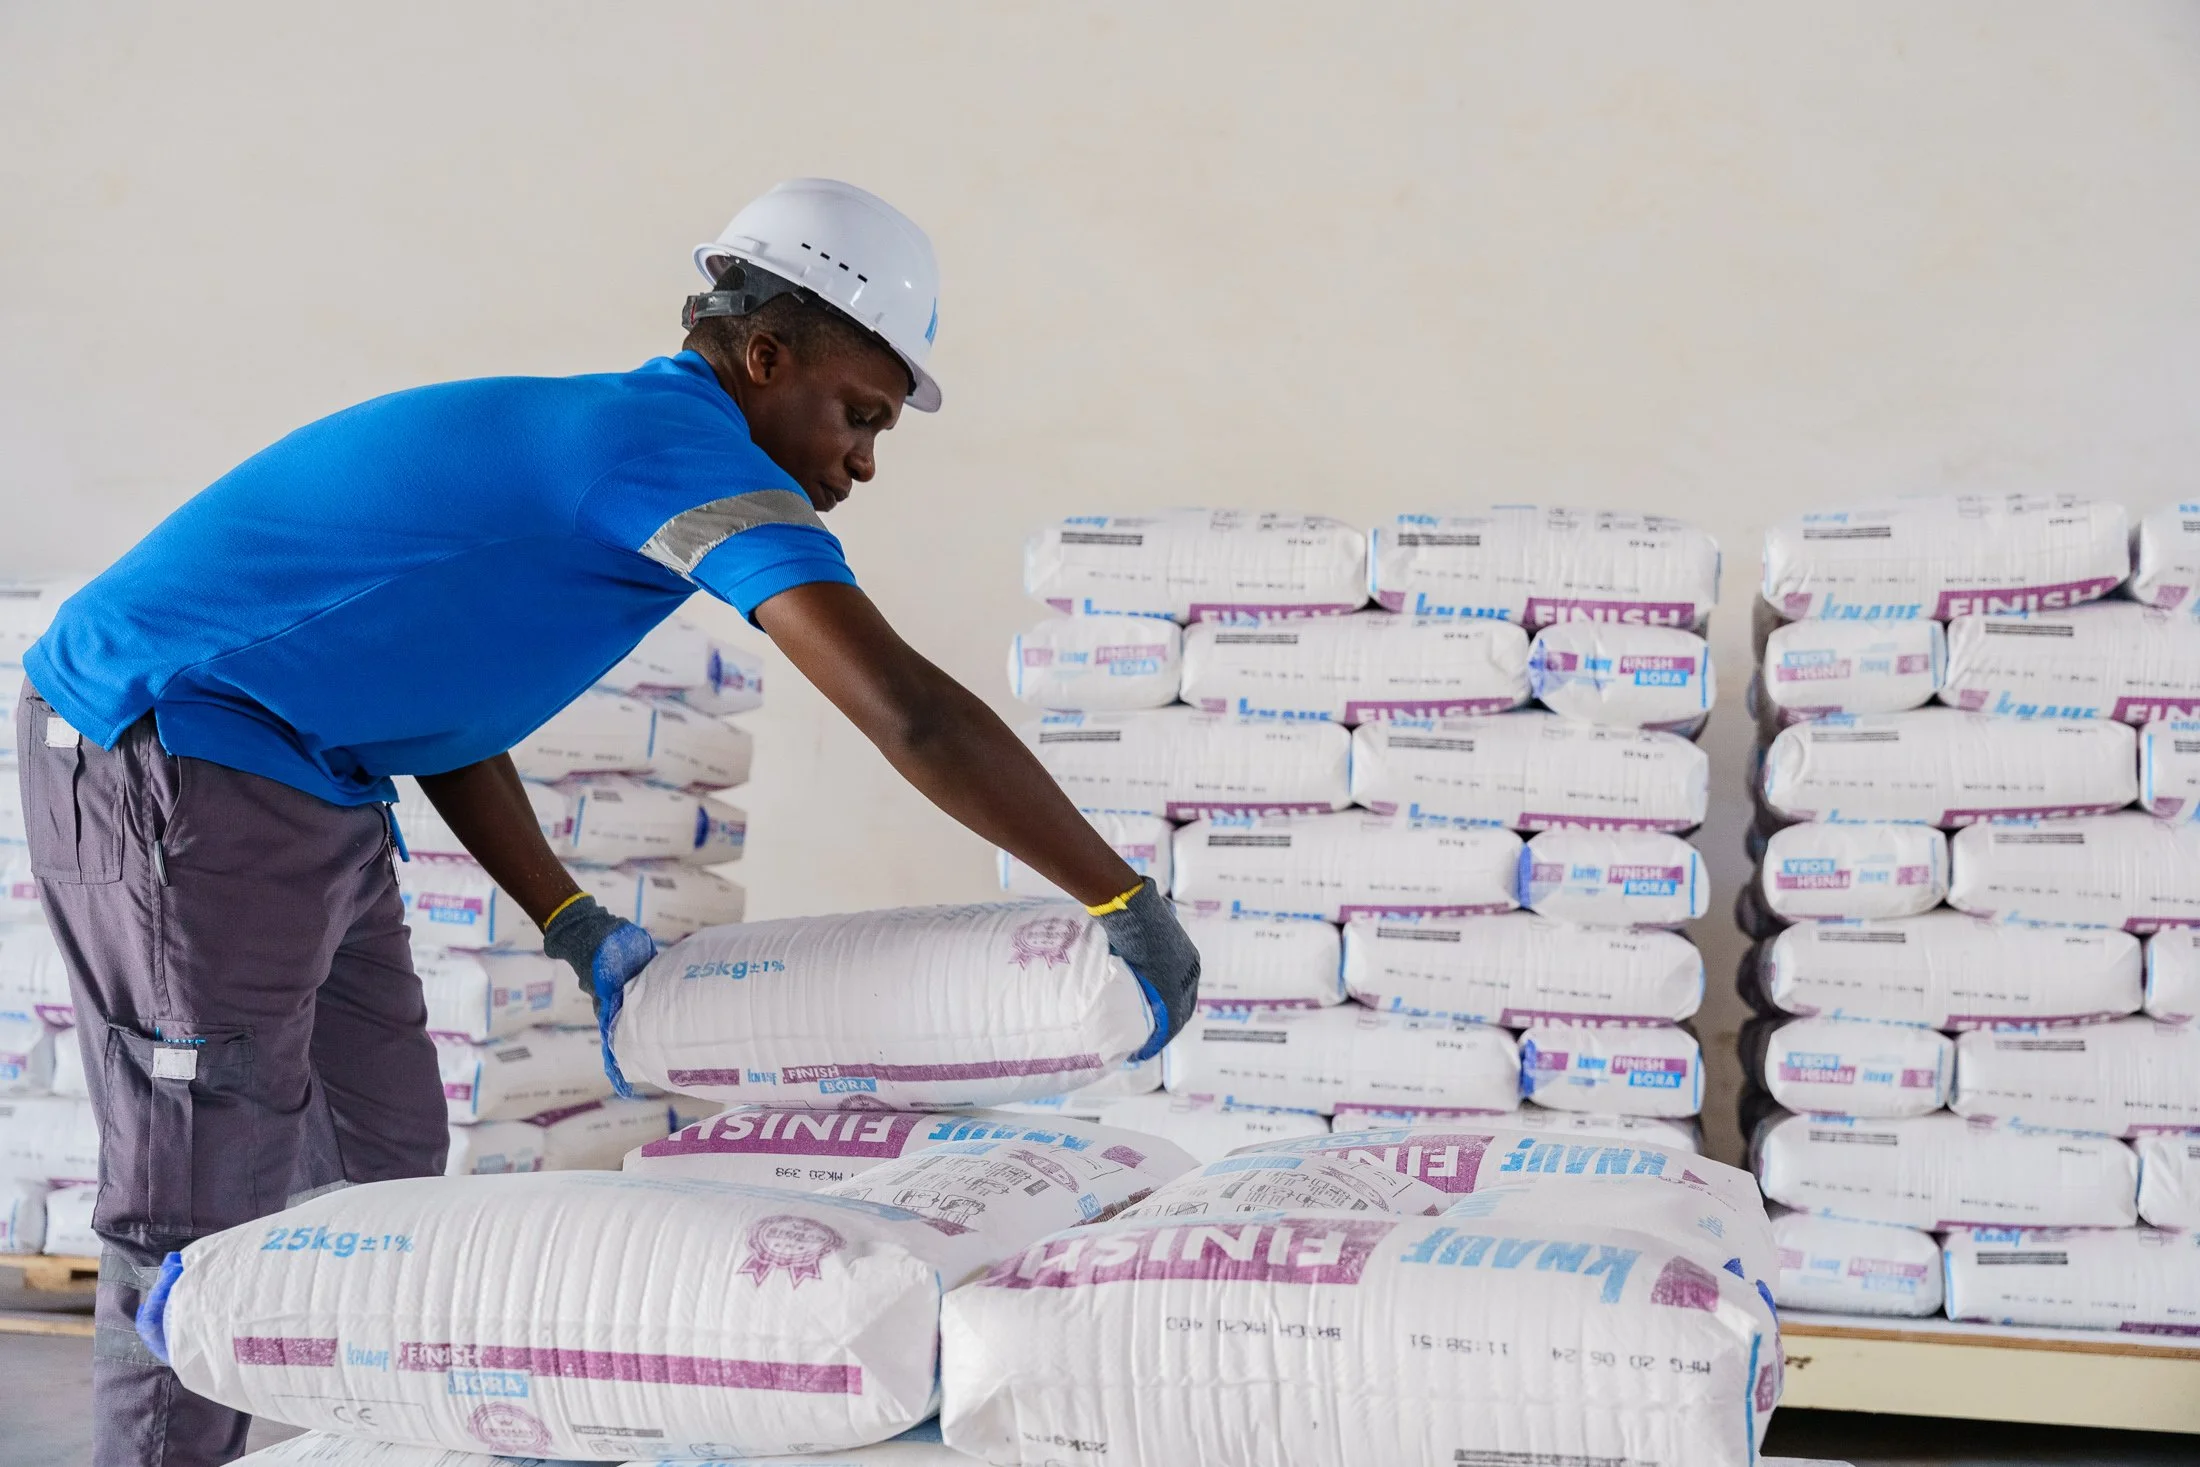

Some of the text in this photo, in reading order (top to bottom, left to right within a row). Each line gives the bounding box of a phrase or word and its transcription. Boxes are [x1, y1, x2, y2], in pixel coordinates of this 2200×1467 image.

[1638, 671, 1681, 685] BORA
[1627, 881, 1671, 895] BORA
[787, 1066, 840, 1081] FINISH
[1631, 1073, 1676, 1087] BORA
[825, 1079, 870, 1095] BORA
[1500, 1137, 1669, 1176] KNAUF
[775, 1167, 801, 1180] 398
[1017, 1224, 1642, 1304] KNAUF FINISH
[1409, 1333, 1509, 1357] 11:58:51
[408, 1344, 481, 1366] FINISH
[1551, 1347, 1577, 1363] 24
[1629, 1355, 1656, 1371] 20
[1669, 1357, 1711, 1375] MFG
[455, 1373, 522, 1393] BORA
